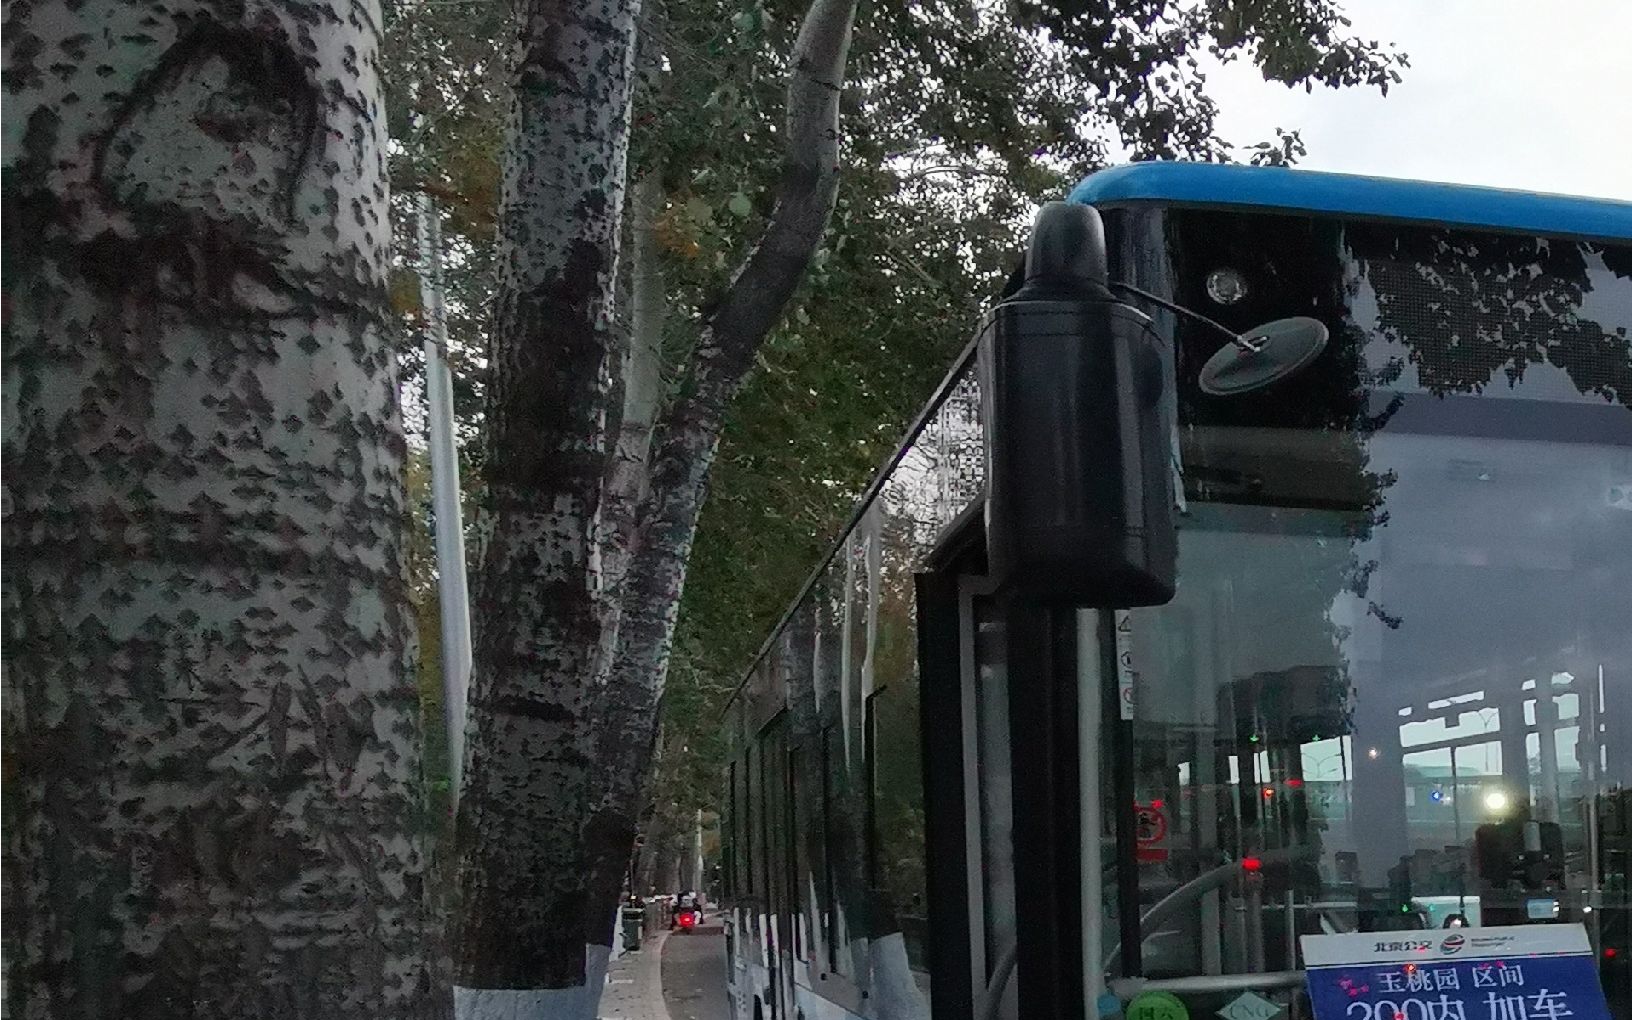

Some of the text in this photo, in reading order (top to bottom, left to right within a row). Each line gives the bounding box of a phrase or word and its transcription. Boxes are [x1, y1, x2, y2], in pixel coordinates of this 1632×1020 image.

[1377, 964, 1524, 993] 玉桃园 区间
